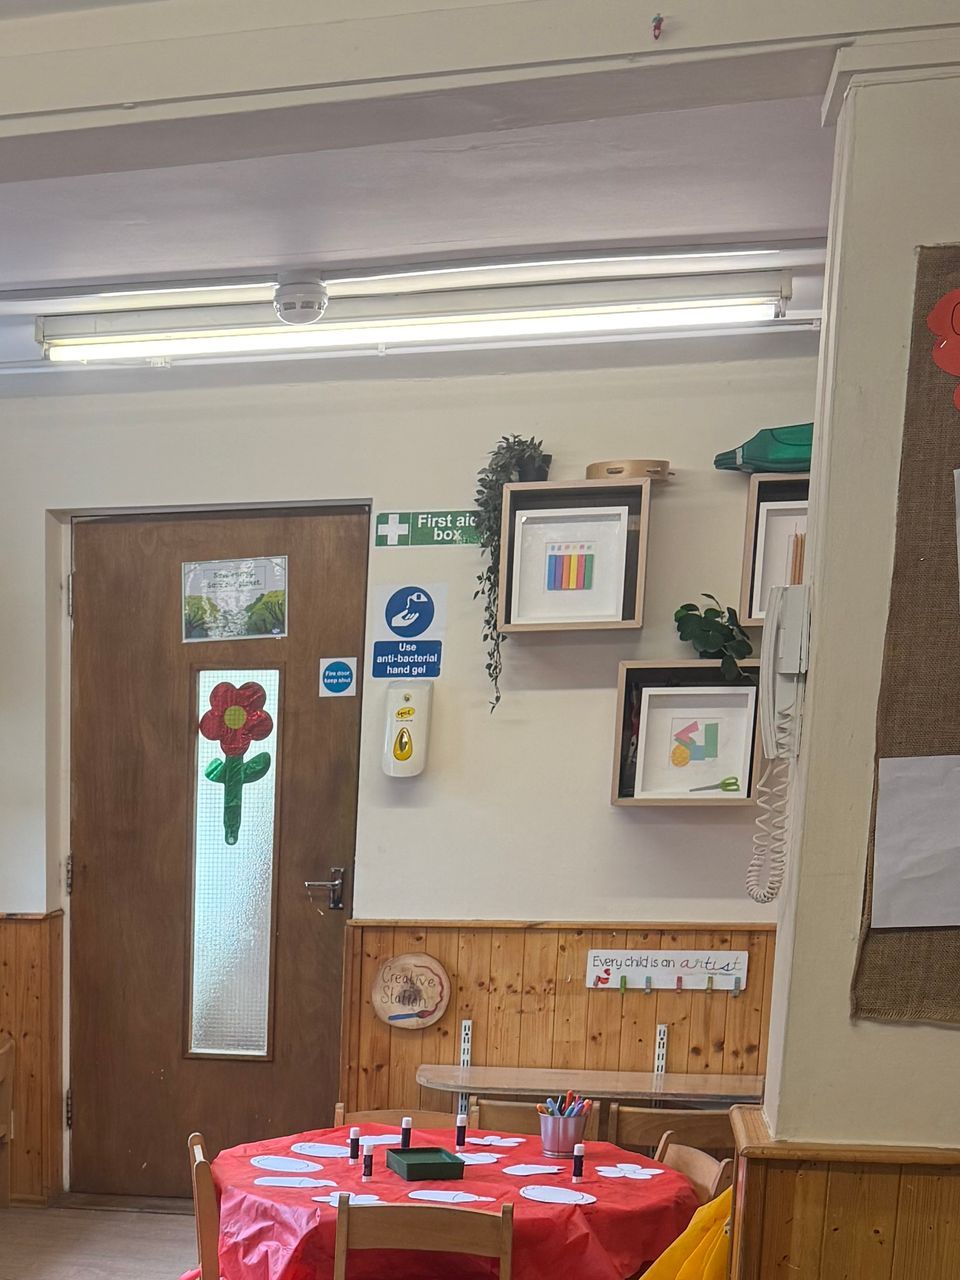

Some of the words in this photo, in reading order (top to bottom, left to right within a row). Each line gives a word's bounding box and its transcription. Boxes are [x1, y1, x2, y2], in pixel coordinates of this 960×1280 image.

[418, 514, 452, 528] First
[433, 527, 462, 541] box
[399, 643, 417, 652] Use
[376, 653, 438, 663] anti-bacterial
[386, 665, 411, 674] hand
[412, 664, 426, 675] gel
[593, 956, 622, 969] Every
[625, 955, 648, 968] child
[650, 956, 658, 968] is
[661, 959, 675, 968] an
[680, 956, 741, 971] artist
[381, 965, 436, 987] Creative
[381, 985, 428, 1008] Station
